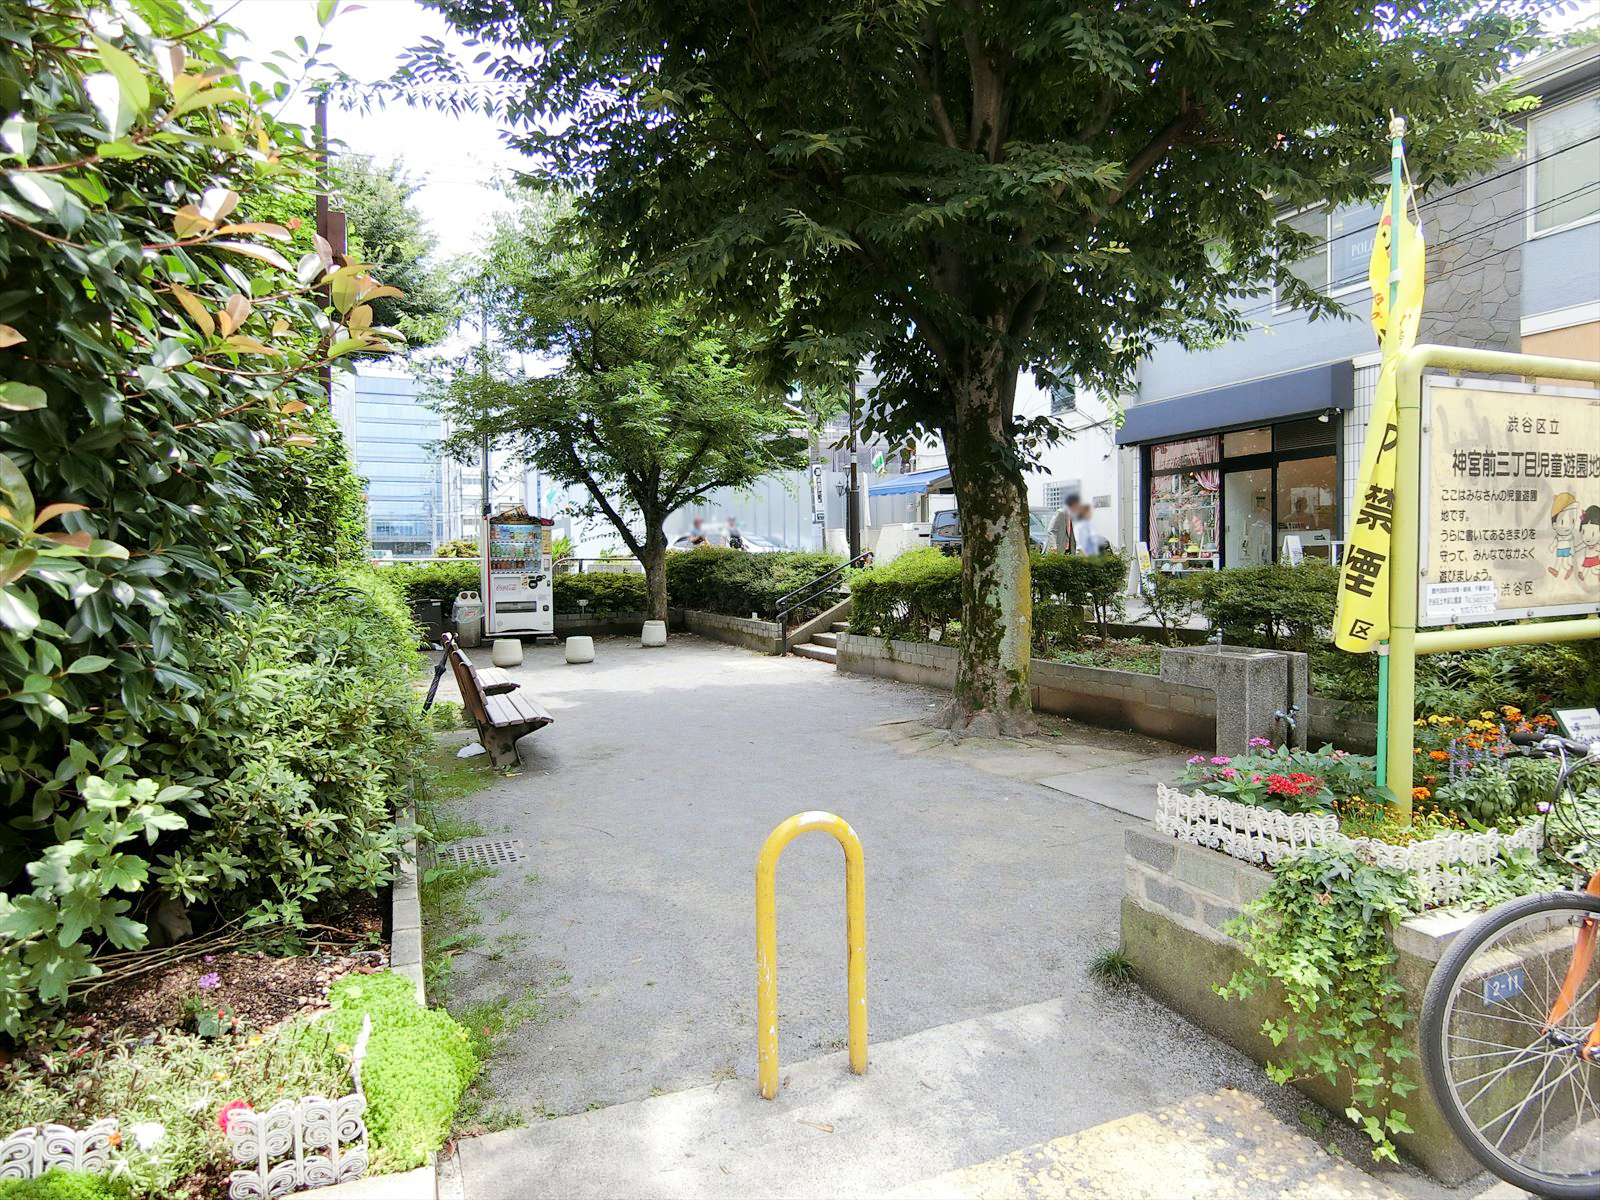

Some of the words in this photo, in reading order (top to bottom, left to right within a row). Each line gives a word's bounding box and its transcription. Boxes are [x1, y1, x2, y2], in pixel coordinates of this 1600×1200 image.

[1507, 416, 1559, 434] 渋谷区立
[1452, 449, 1600, 478] 神宮前三丁目児童遊園地
[1441, 489, 1537, 501] ここはみなさんの児童遊園
[1441, 509, 1469, 521] 地です。
[1440, 528, 1536, 542] うらに書いてあるきまりを
[1440, 547, 1535, 562] 守って、みんなでなかよく
[1439, 568, 1492, 583] 遊びましょう。
[1501, 581, 1533, 596] 渋谷区
[1493, 975, 1518, 996] 2-11
